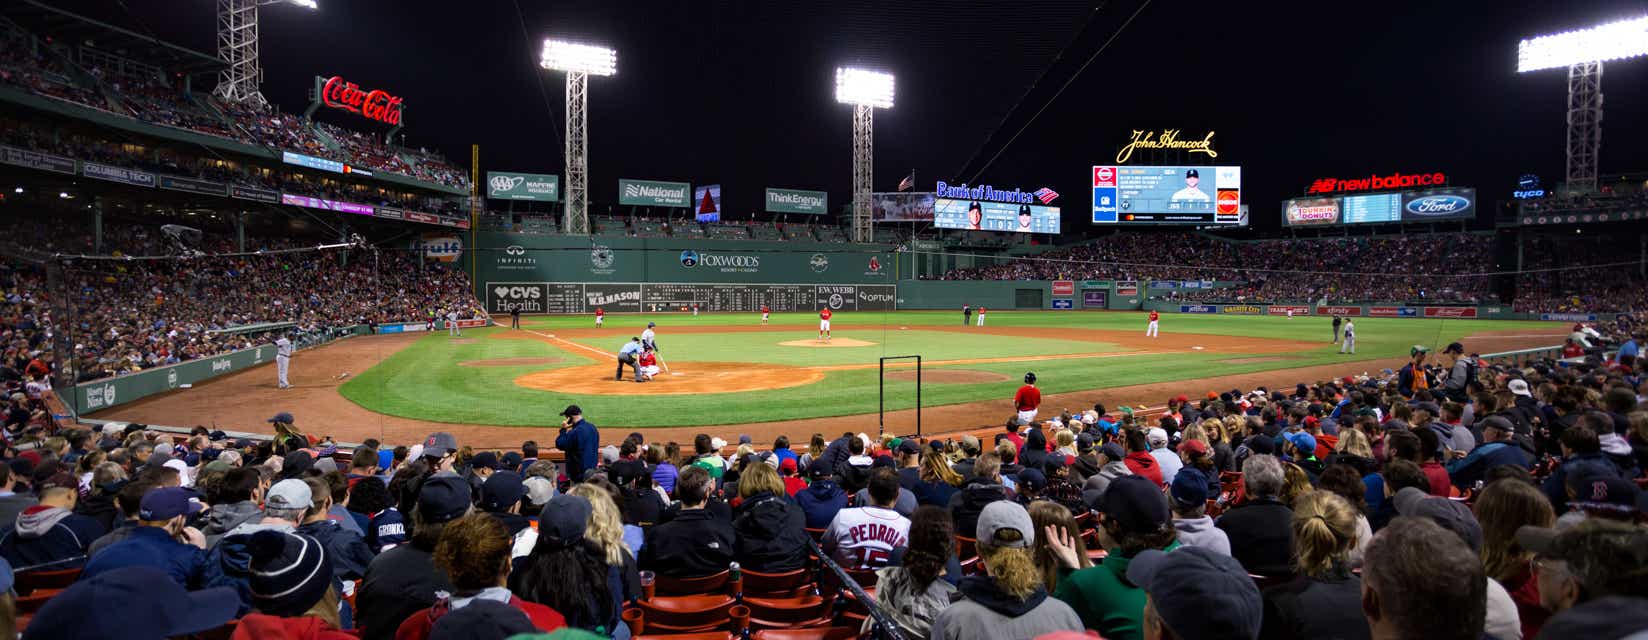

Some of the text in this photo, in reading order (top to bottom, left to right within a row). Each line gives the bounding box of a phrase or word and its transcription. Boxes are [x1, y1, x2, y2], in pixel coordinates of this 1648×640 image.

[323, 76, 402, 124] Coca-Cola
[1116, 128, 1217, 163] John Hancock
[85, 163, 152, 182] COLUMBIA TECH
[1338, 178, 1371, 191] new
[1371, 172, 1445, 189] balance
[639, 185, 684, 198] National
[936, 181, 1034, 203] Bank of America
[1513, 190, 1545, 198] tyco
[768, 192, 822, 206] ThinkEnergy
[1418, 198, 1457, 212] Ford
[699, 252, 760, 266] FOXWOODS
[510, 286, 540, 299] CVS
[867, 294, 893, 302] OPTUM
[496, 299, 541, 312] Health
